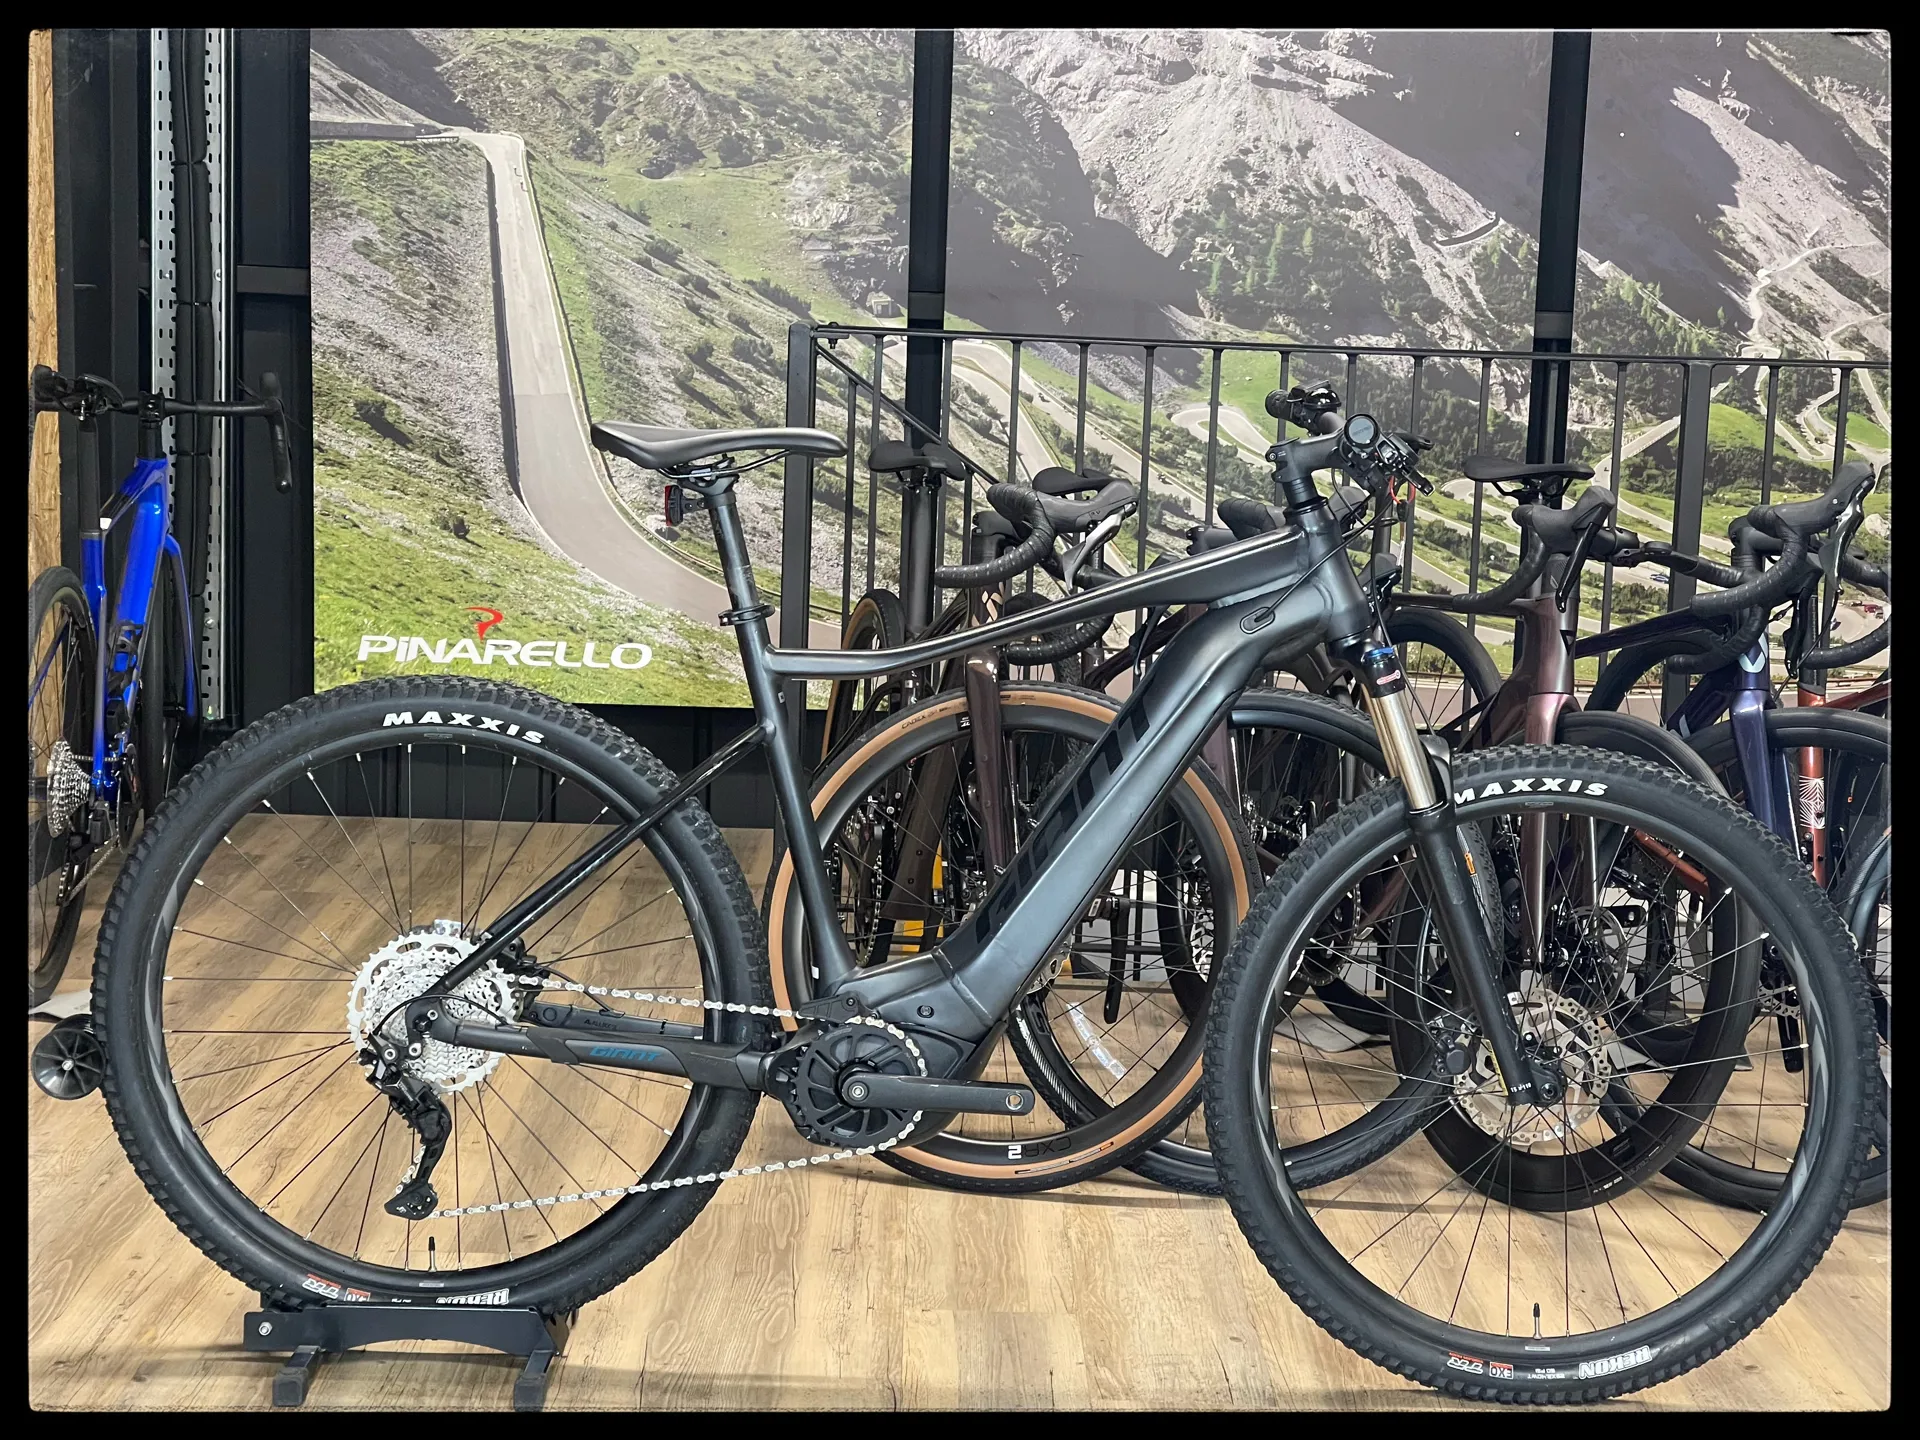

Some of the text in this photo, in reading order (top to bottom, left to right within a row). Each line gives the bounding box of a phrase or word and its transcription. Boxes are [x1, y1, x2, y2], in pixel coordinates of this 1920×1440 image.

[357, 635, 652, 669] PINARELLO
[382, 710, 545, 744] MAXXIS
[1454, 777, 1609, 805] MAXXIS
[590, 1046, 660, 1061] GIANT
[1491, 1365, 1513, 1379] EXO
[1579, 1345, 1652, 1380] REKON
